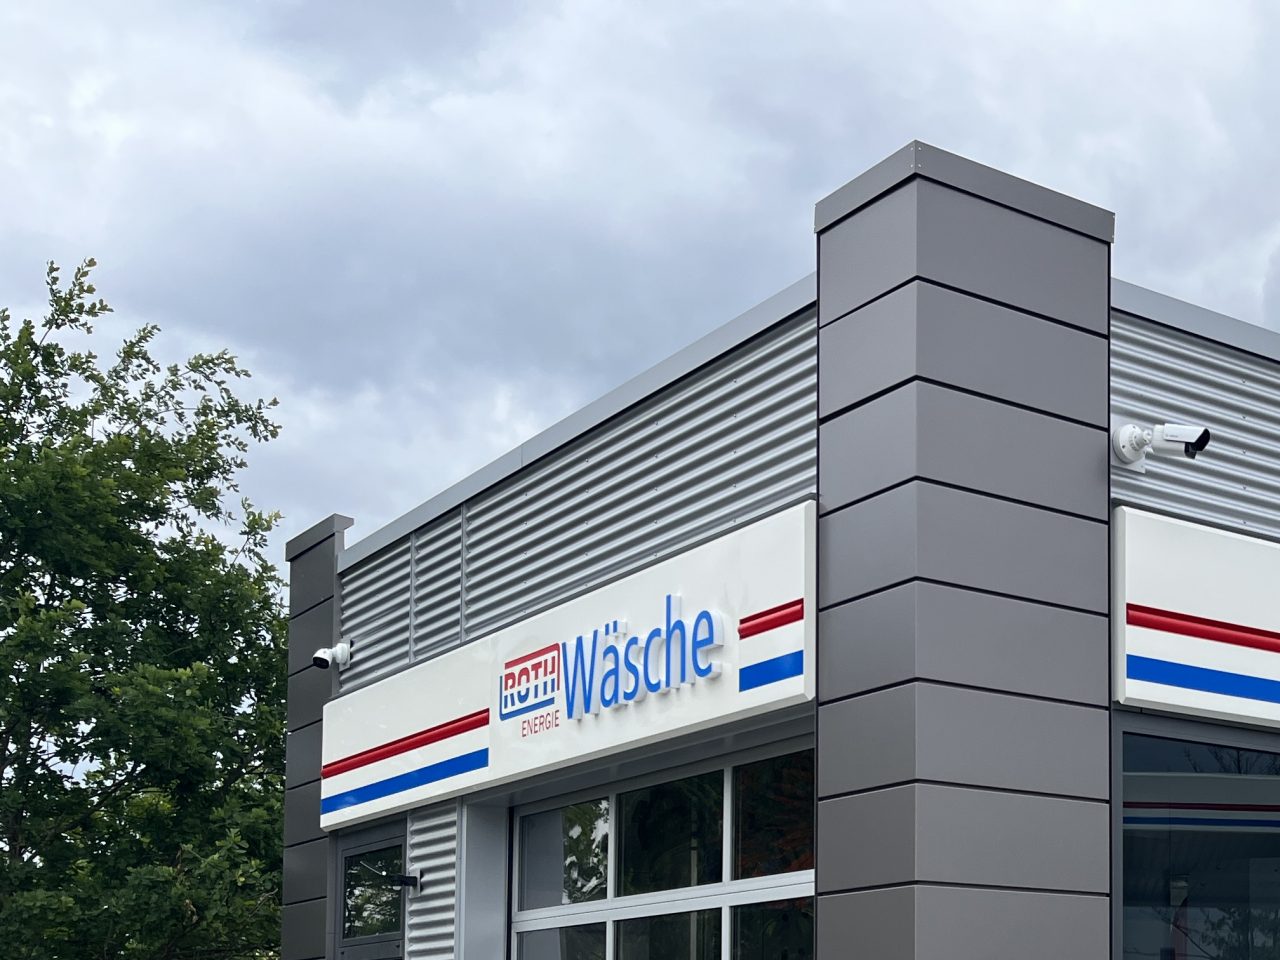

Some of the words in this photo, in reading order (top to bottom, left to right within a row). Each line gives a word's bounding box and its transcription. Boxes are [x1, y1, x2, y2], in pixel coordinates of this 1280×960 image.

[503, 655, 556, 709] ROTH
[561, 594, 715, 720] Wäsche
[521, 709, 560, 738] ENERGIE
